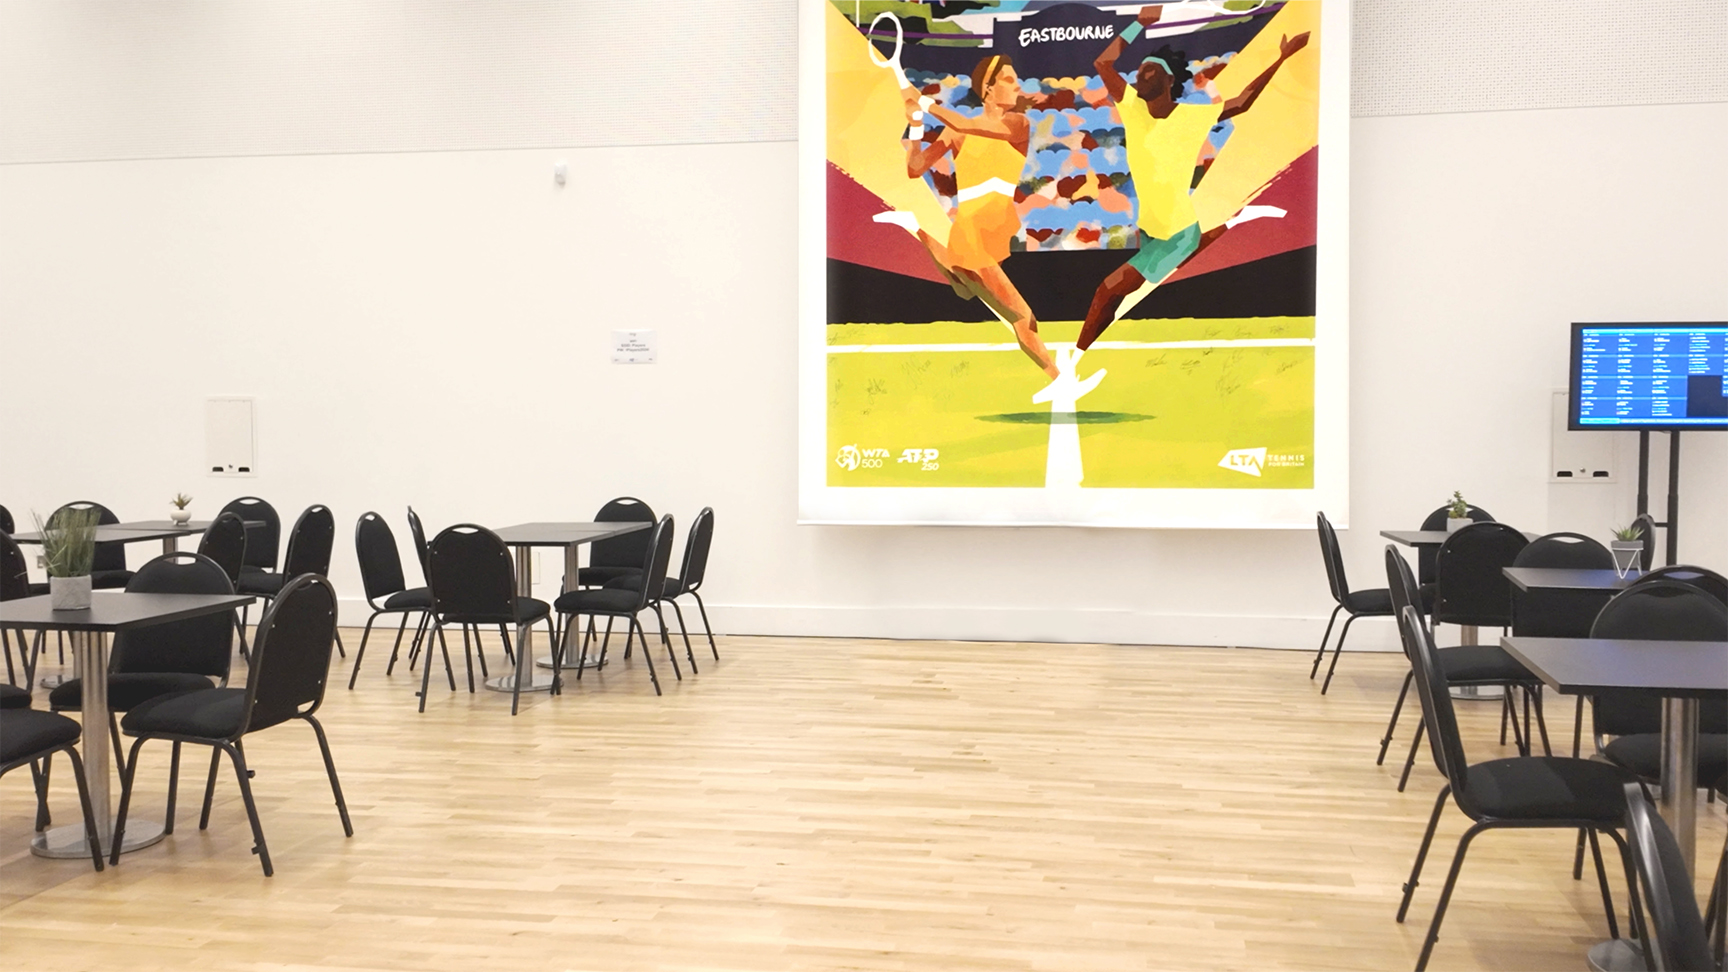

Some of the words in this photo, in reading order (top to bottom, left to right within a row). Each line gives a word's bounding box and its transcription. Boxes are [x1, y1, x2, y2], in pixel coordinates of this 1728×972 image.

[1018, 24, 1114, 47] EASTBOURNE
[862, 449, 890, 458] WTA
[897, 448, 940, 464] ATP
[1267, 454, 1305, 462] TENNIS
[862, 459, 883, 469] 500
[1230, 454, 1260, 467] LTA
[921, 462, 940, 471] 250
